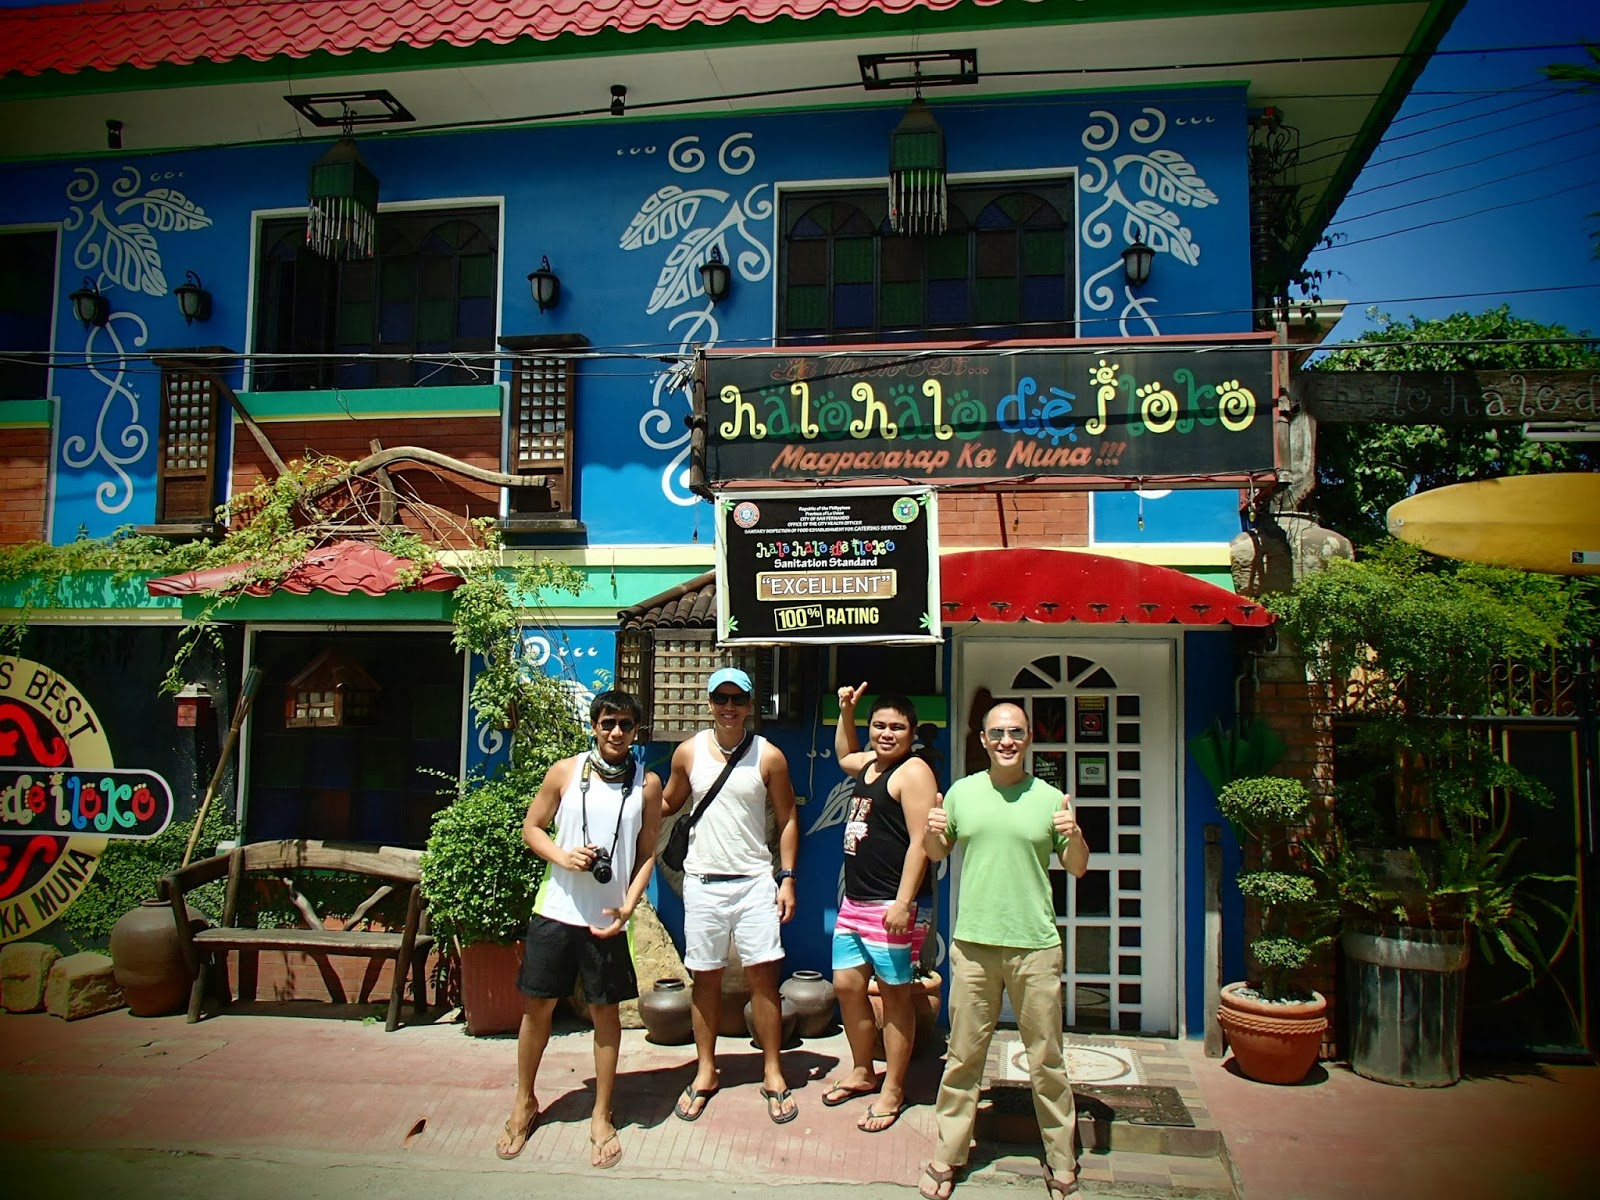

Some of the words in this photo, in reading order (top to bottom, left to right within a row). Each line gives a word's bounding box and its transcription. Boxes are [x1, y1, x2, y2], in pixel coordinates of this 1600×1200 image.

[770, 443, 950, 475] Magpasarap
[956, 442, 996, 469] Ka
[774, 558, 828, 568] Sanitation
[828, 557, 878, 567] Standard
[778, 606, 820, 628] 100%
[826, 606, 880, 625] RATING
[25, 669, 98, 740] BEST
[30, 848, 97, 921] MUNA
